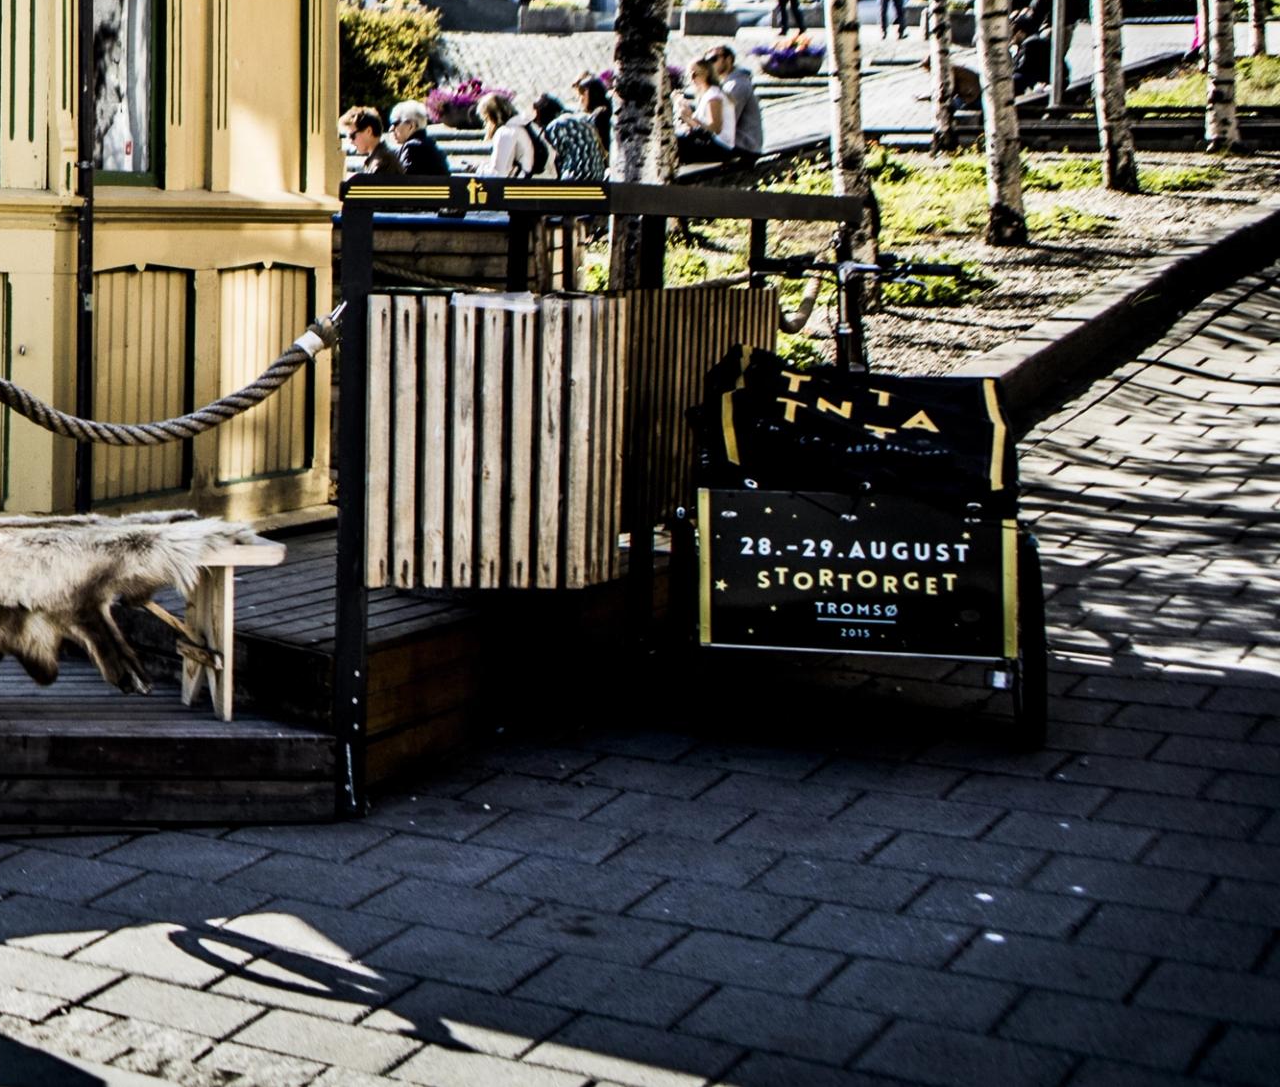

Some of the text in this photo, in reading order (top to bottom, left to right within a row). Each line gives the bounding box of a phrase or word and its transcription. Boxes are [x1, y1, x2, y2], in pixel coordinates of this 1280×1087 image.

[757, 567, 958, 596] STORTORGET
[815, 602, 899, 617] TROMSØ
[840, 628, 871, 639] 2015
